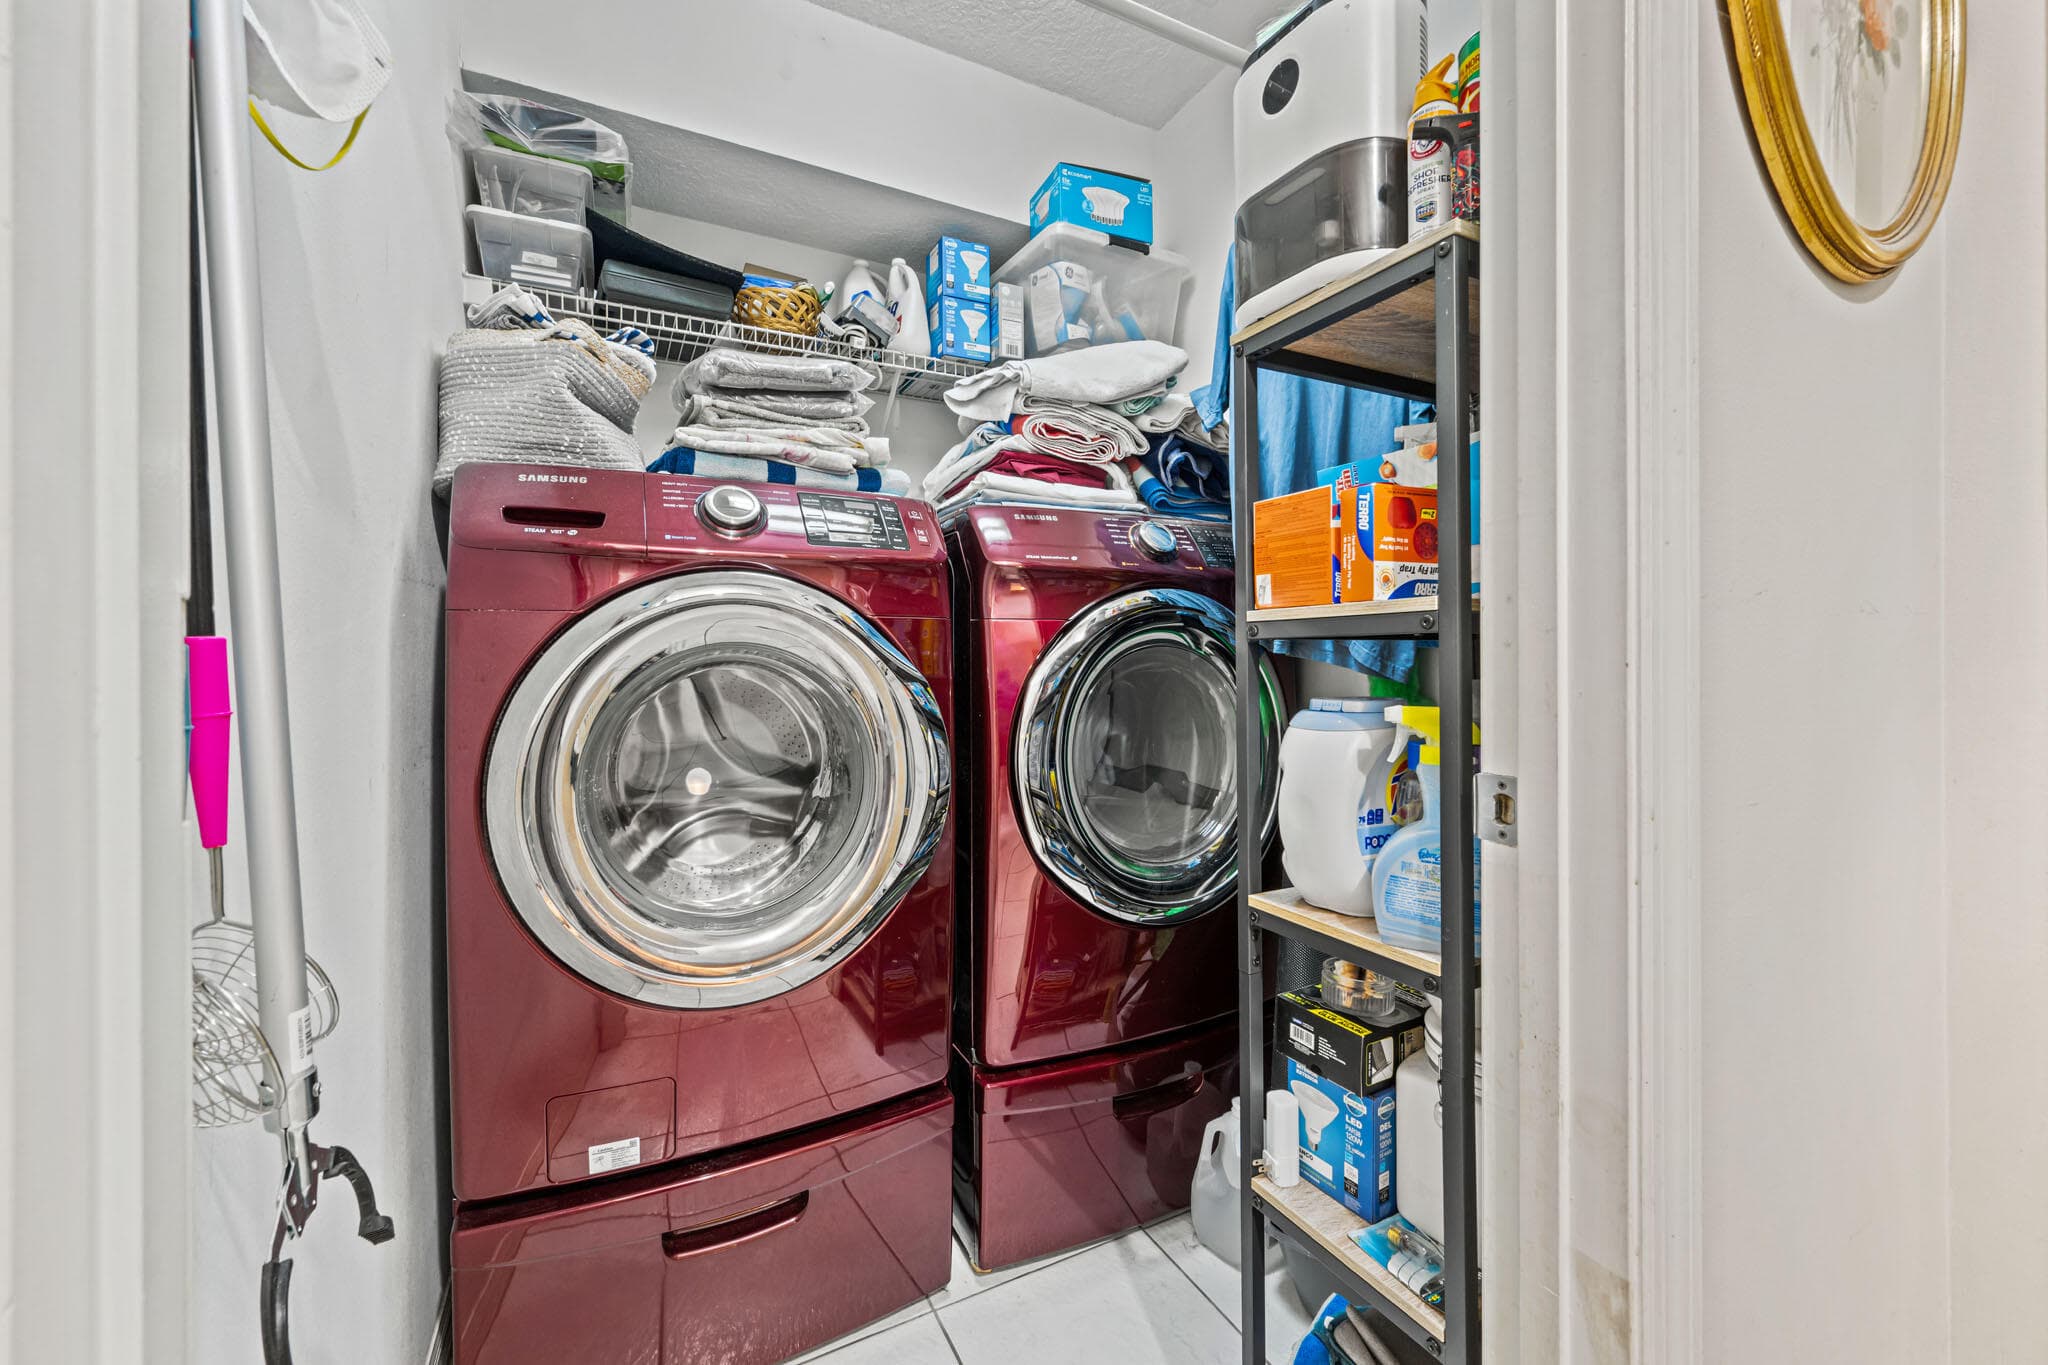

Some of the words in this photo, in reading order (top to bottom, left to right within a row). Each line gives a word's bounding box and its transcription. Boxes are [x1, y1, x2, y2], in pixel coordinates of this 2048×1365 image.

[518, 474, 588, 484] SAMSUNG
[1358, 492, 1371, 531] TERRO
[1014, 513, 1058, 522] SAMSUNG
[1399, 564, 1416, 574] Trap
[1417, 565, 1428, 575] Fly
[1414, 582, 1438, 596] ERRO
[1345, 1114, 1363, 1129] LED
[1379, 1121, 1392, 1133] DEL
